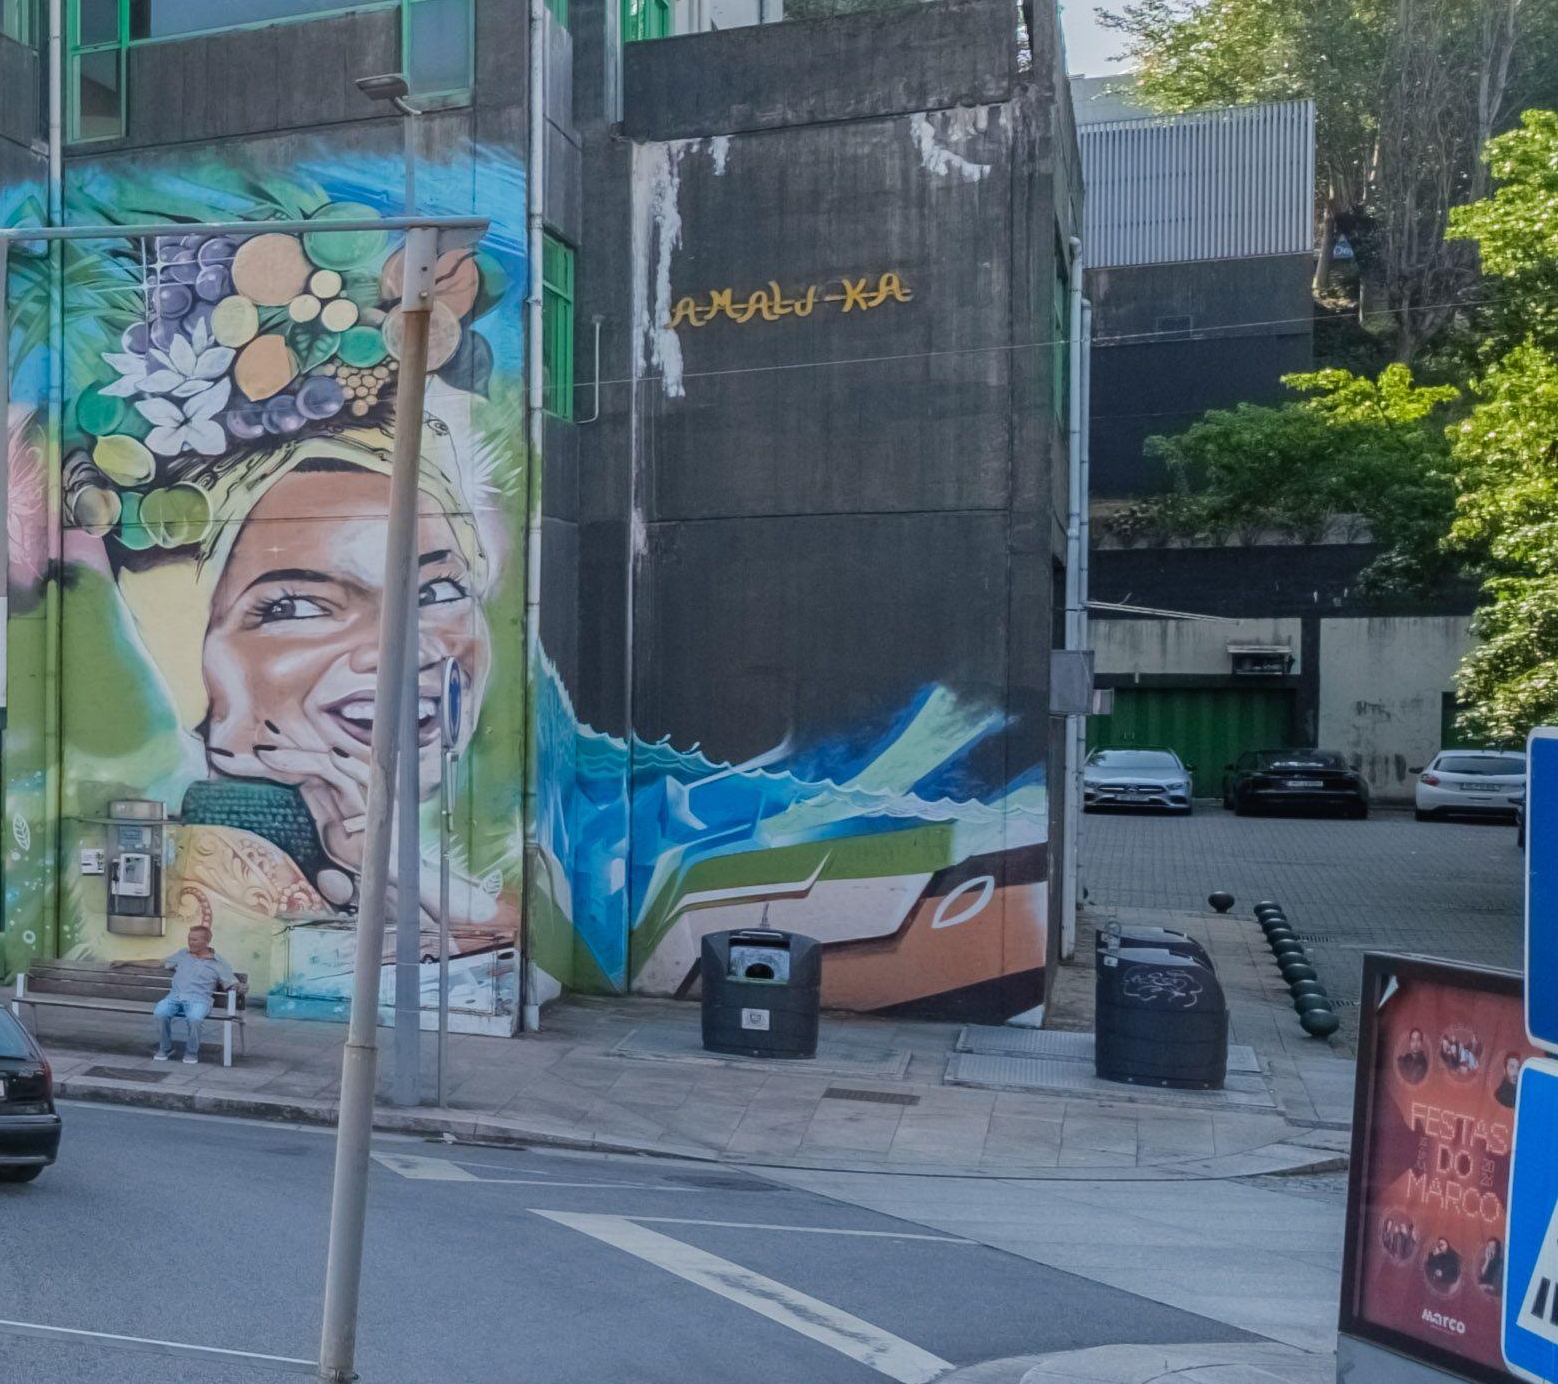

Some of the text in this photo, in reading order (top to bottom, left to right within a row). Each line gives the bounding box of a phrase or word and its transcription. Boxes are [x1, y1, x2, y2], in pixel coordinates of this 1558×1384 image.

[1410, 1102, 1509, 1156] FESTAS
[1436, 1144, 1474, 1179] DO
[1406, 1167, 1503, 1223] MARCO
